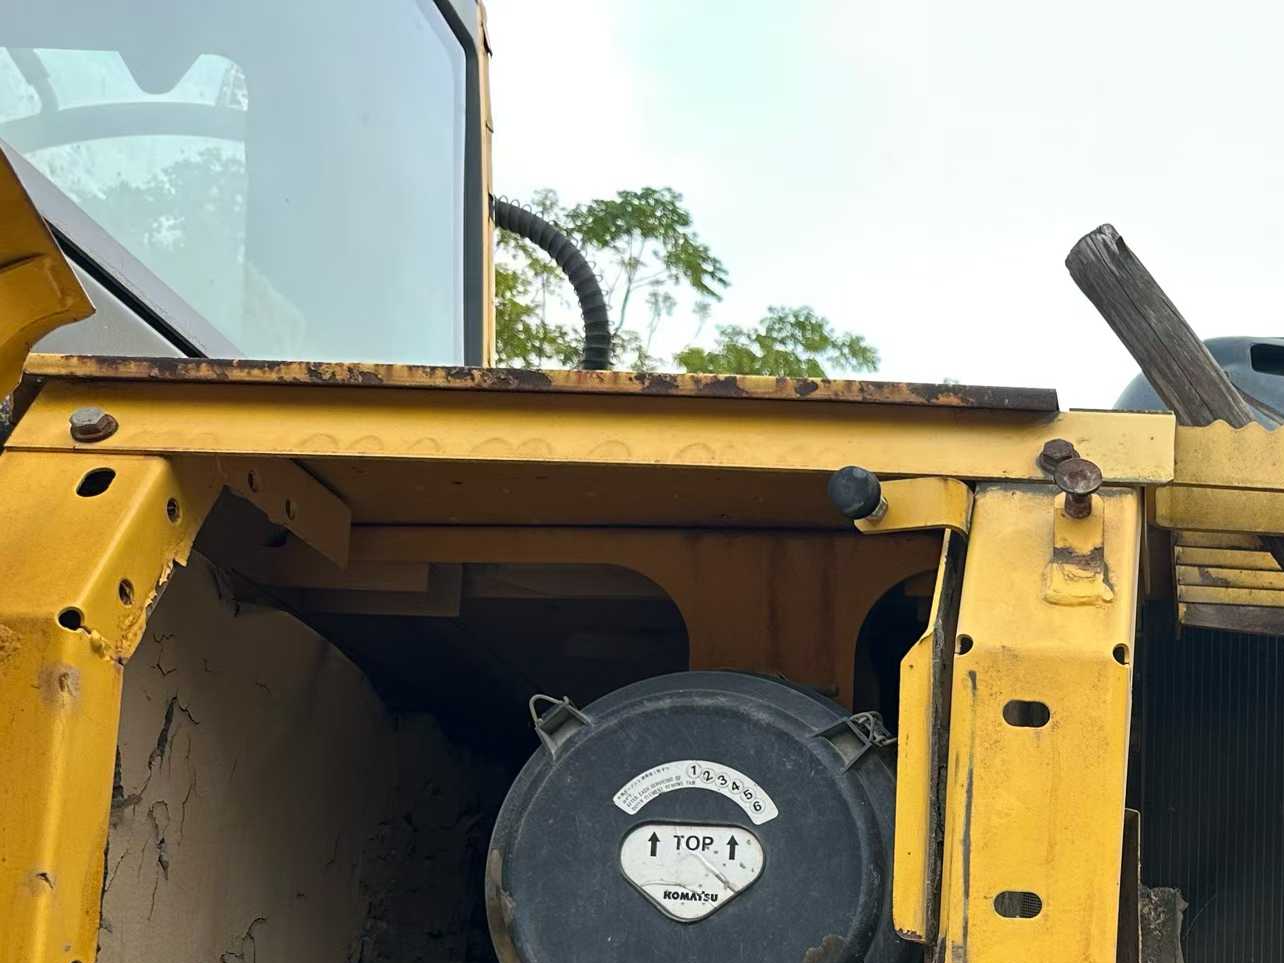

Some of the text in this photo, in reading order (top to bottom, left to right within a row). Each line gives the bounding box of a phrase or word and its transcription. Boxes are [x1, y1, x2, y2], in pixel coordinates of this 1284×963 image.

[702, 770, 714, 782] 2
[718, 775, 729, 787] 3
[731, 781, 742, 792] 4
[743, 789, 754, 800] 5
[752, 801, 763, 812] 6
[673, 834, 715, 852] TOP
[663, 890, 719, 902] KOMATSU
